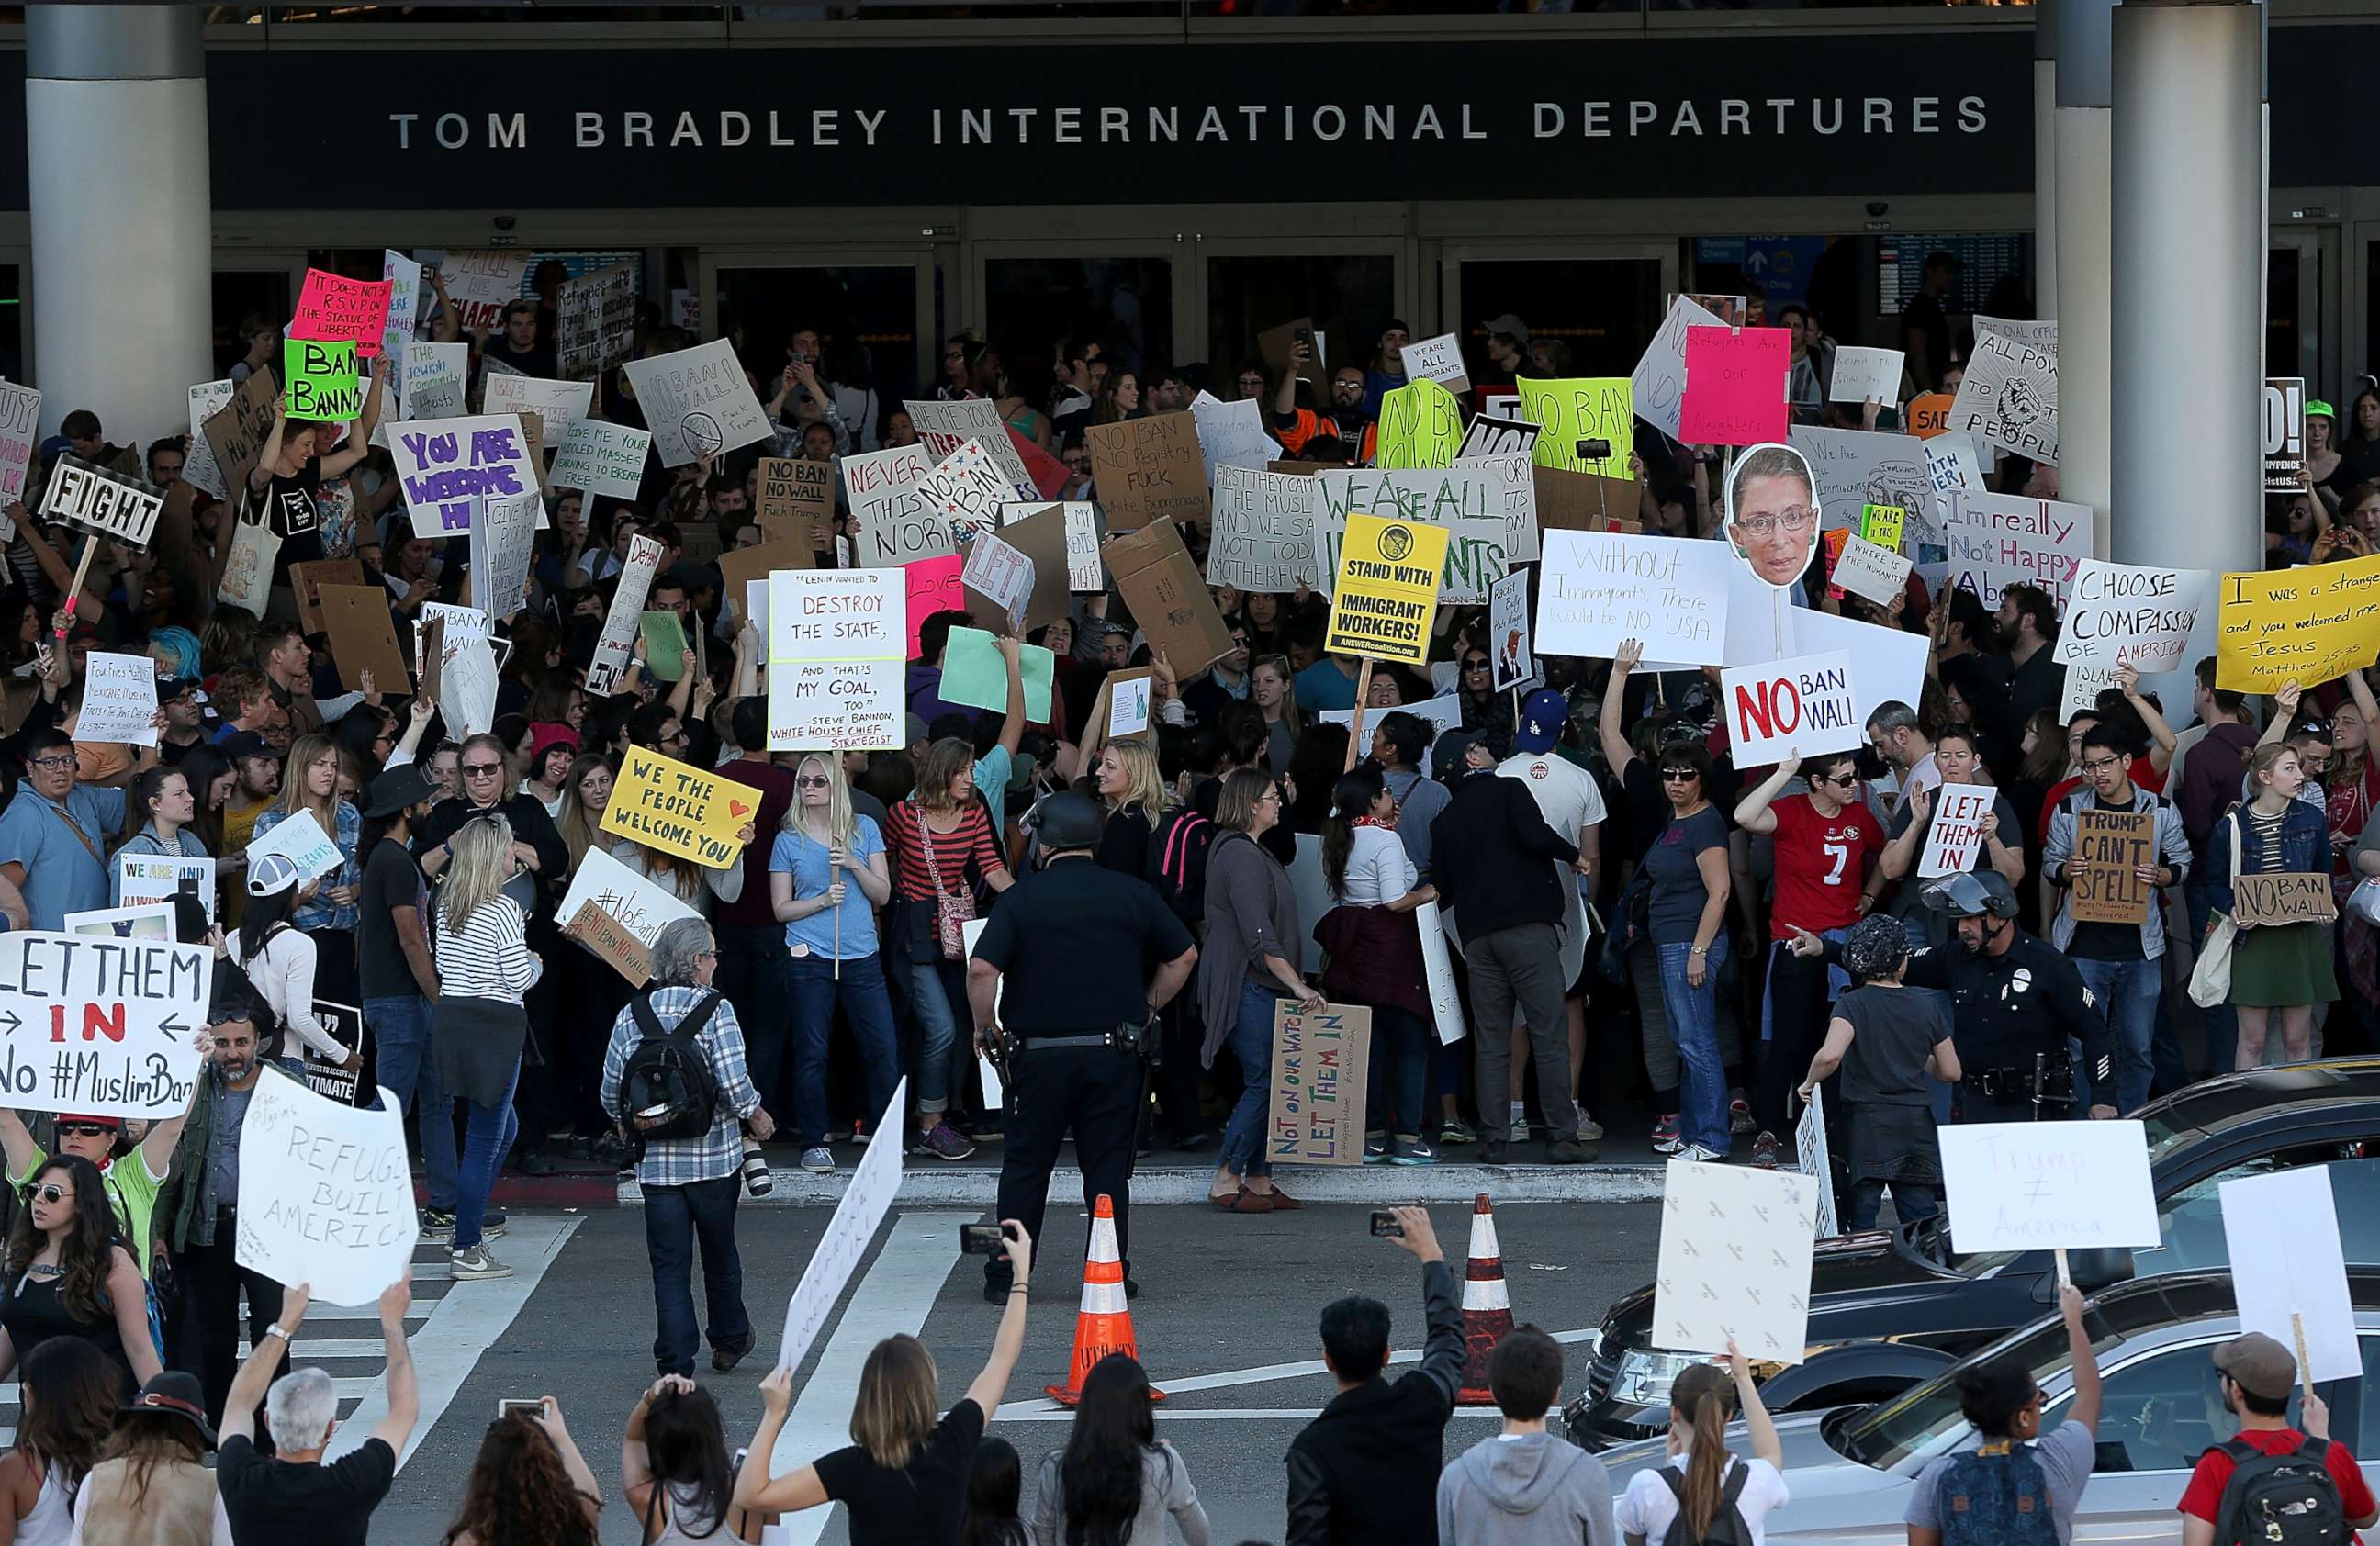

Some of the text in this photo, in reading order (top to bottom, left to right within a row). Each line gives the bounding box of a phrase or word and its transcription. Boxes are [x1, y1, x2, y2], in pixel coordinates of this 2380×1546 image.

[390, 96, 1993, 149] TOM BRADLEY INTERNATIONAL DEPARTURES
[331, 279, 357, 296] DOES
[558, 268, 630, 309] Refugees are
[299, 307, 380, 324] THE STATUE OF
[1689, 329, 1778, 353] Refugees Are
[2004, 325, 2027, 339] OVAL
[304, 344, 357, 377] BAN
[1414, 342, 1445, 356] WE ARE
[1981, 336, 2015, 361] ALL
[1410, 364, 1461, 380] IMMIGRANTS
[1421, 355, 1446, 370] ALL
[1633, 361, 1677, 409] NO
[1969, 379, 1991, 395] TO
[417, 389, 454, 412] Atheists
[641, 375, 731, 427] NO WALL
[1386, 386, 1421, 440] NO
[1522, 386, 1560, 436] NO
[1574, 386, 1633, 436] BAN
[906, 404, 1004, 430] GIVE ME YOUR
[1697, 413, 1761, 438] Neighbors
[594, 429, 648, 451] ME YOUR
[1092, 418, 1179, 452] NO BAN
[1966, 413, 2058, 461] PEOPLE
[400, 432, 459, 471] YOU
[470, 428, 522, 466] ARE
[597, 447, 641, 465] MASSES
[1095, 451, 1129, 473] NO
[1132, 446, 1191, 469] Registry
[595, 465, 607, 475] TO
[768, 462, 827, 483] NO BAN
[850, 454, 926, 493] NEVER
[1128, 469, 1175, 492] FUCK
[1217, 465, 1285, 494] FIRST THEY
[404, 465, 524, 505] WELCOME
[765, 482, 825, 500] NO WALL
[918, 455, 1003, 515] NO BAN
[1319, 472, 1505, 522] WE ARE ALL
[1817, 480, 1867, 498] IMMIGRANTS
[53, 469, 159, 538] FIGHT
[862, 492, 922, 524] THIS
[1223, 487, 1253, 510] THE
[764, 504, 821, 520] Fuck Trump
[1075, 509, 1091, 528] MY
[1216, 508, 1283, 536] AND WE
[1872, 510, 1900, 524] WE ARE
[1992, 501, 2075, 544] really
[1219, 535, 1257, 556] NOT
[1854, 543, 1887, 564] WHERE
[1892, 560, 1900, 571] IS
[1951, 534, 2080, 582] Not Happy
[1347, 559, 1432, 587] STAND WITH
[1846, 555, 1862, 566] THE
[835, 575, 878, 583] WANTED TO
[908, 573, 961, 599] Love
[1494, 581, 1515, 600] Racist
[2080, 571, 2176, 600] CHOOSE
[803, 595, 883, 614] DESTROY
[1341, 593, 1425, 621] IMMIGRANT
[1660, 588, 1707, 611] There
[2268, 587, 2319, 603] was a
[447, 611, 488, 632] BAN!
[792, 621, 887, 641] THE STATE,
[1337, 613, 1420, 642] WORKERS!
[1600, 608, 1711, 642] be NO USA
[2226, 602, 2380, 637] and you welcomed me
[1340, 637, 1416, 656] ANSWERcoalition.org
[2065, 642, 2098, 659] BE
[2251, 643, 2362, 676] Matthew 25:35
[801, 666, 871, 677] AND THAT'S
[2307, 661, 2351, 683] BAN
[796, 680, 877, 698] MY GOAL,
[2075, 683, 2083, 692] IS
[852, 712, 895, 723] BANNON,
[1735, 667, 1846, 743] NO BAN
[1802, 696, 1858, 732] WALL
[771, 725, 881, 739] WHITE HOUSE CHIEF
[832, 734, 892, 748] STRATEGIST
[634, 758, 714, 801] WE THE
[641, 789, 707, 826] PEOPLE,
[1942, 795, 1985, 820] LET
[291, 824, 309, 841] THE
[615, 808, 733, 863] WELCOME YOU
[1935, 823, 1984, 847] THEM
[2080, 812, 2146, 833] TRUMP
[1937, 849, 1965, 870] IN
[2082, 835, 2149, 866] CAN'T
[125, 863, 205, 880] WE ARE AND
[1823, 843, 1848, 885] 7
[2076, 868, 2146, 904] SPELL
[2239, 878, 2324, 917] NO BAN
[2279, 899, 2333, 916] WALL
[91, 944, 202, 1002] THEM
[49, 1003, 126, 1043] IN
[50, 1050, 194, 1107] #MuslimBan
[1273, 1003, 1304, 1155] NOT ON OUR WATCH
[1307, 1014, 1344, 1159] LET THEM IN
[1976, 1134, 2087, 1185] Trump
[313, 1182, 405, 1216] BUILT
[1994, 1205, 2104, 1241] America
